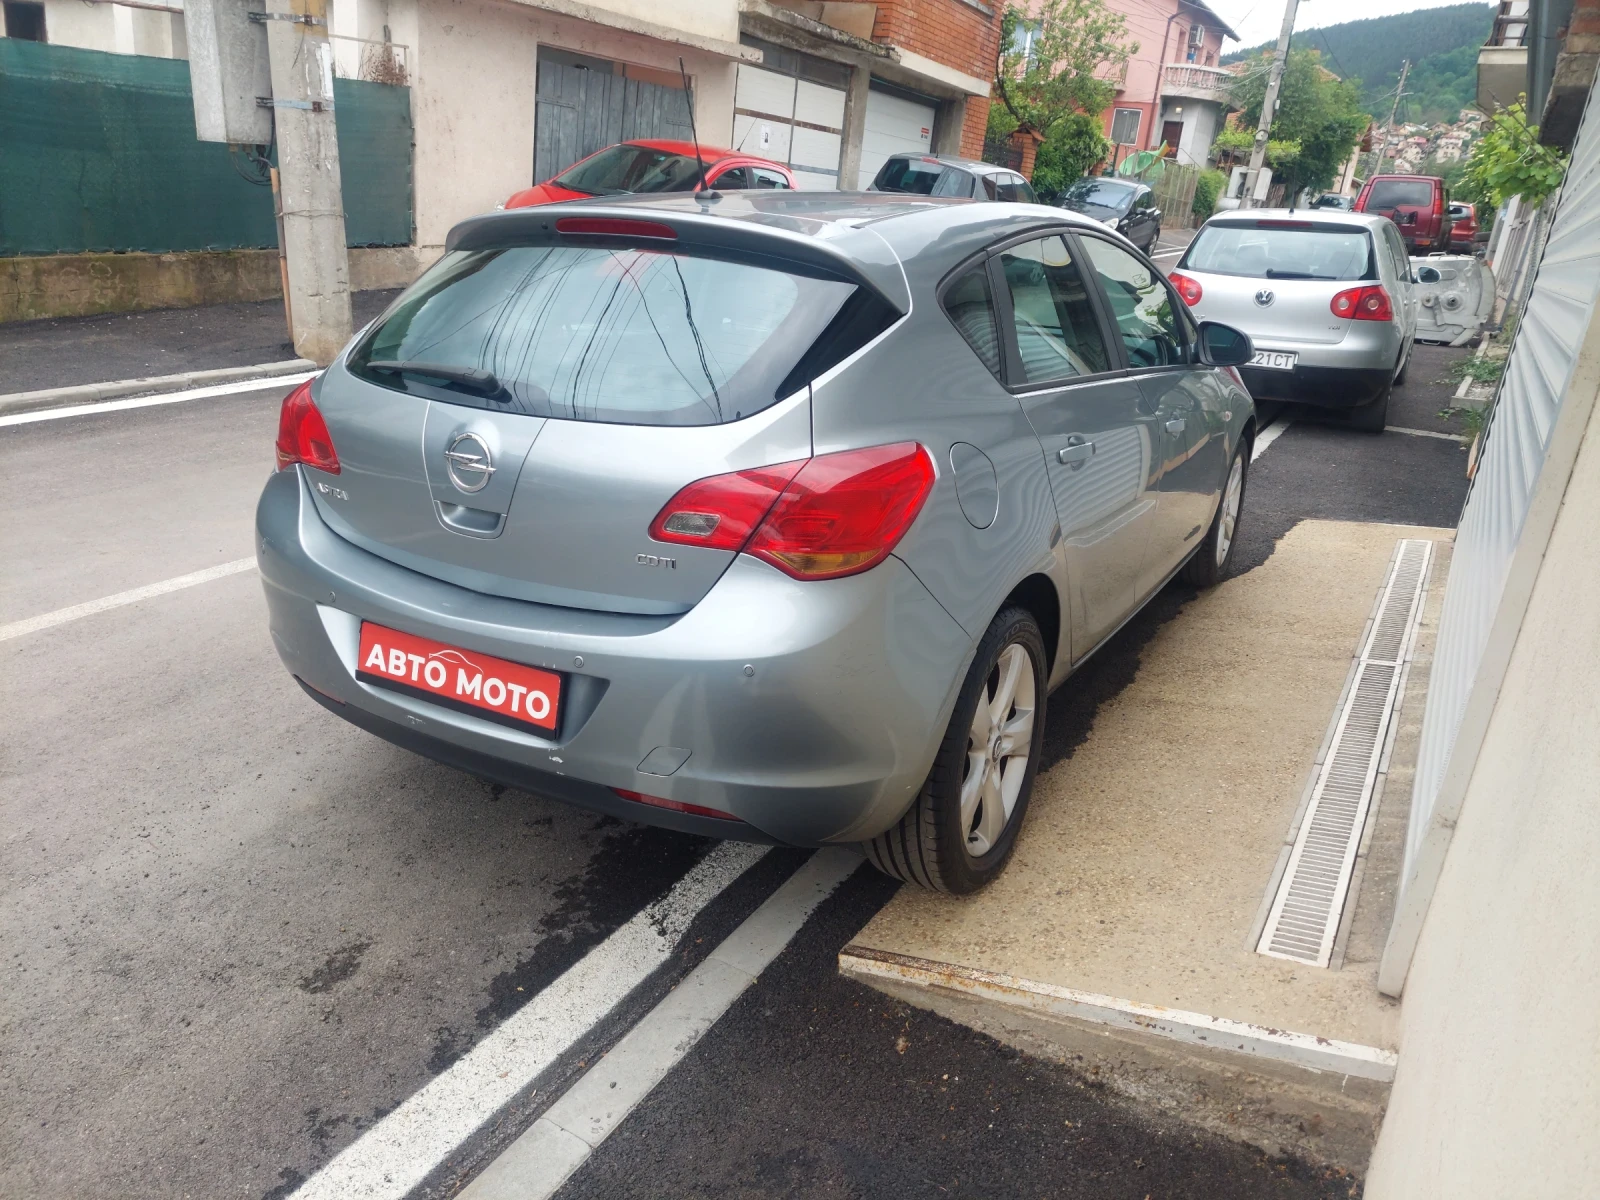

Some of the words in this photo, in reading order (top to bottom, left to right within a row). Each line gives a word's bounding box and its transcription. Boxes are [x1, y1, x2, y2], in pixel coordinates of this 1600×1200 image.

[635, 553, 677, 570] CDTI
[365, 643, 447, 688] АВТО
[456, 668, 551, 720] МОТО
